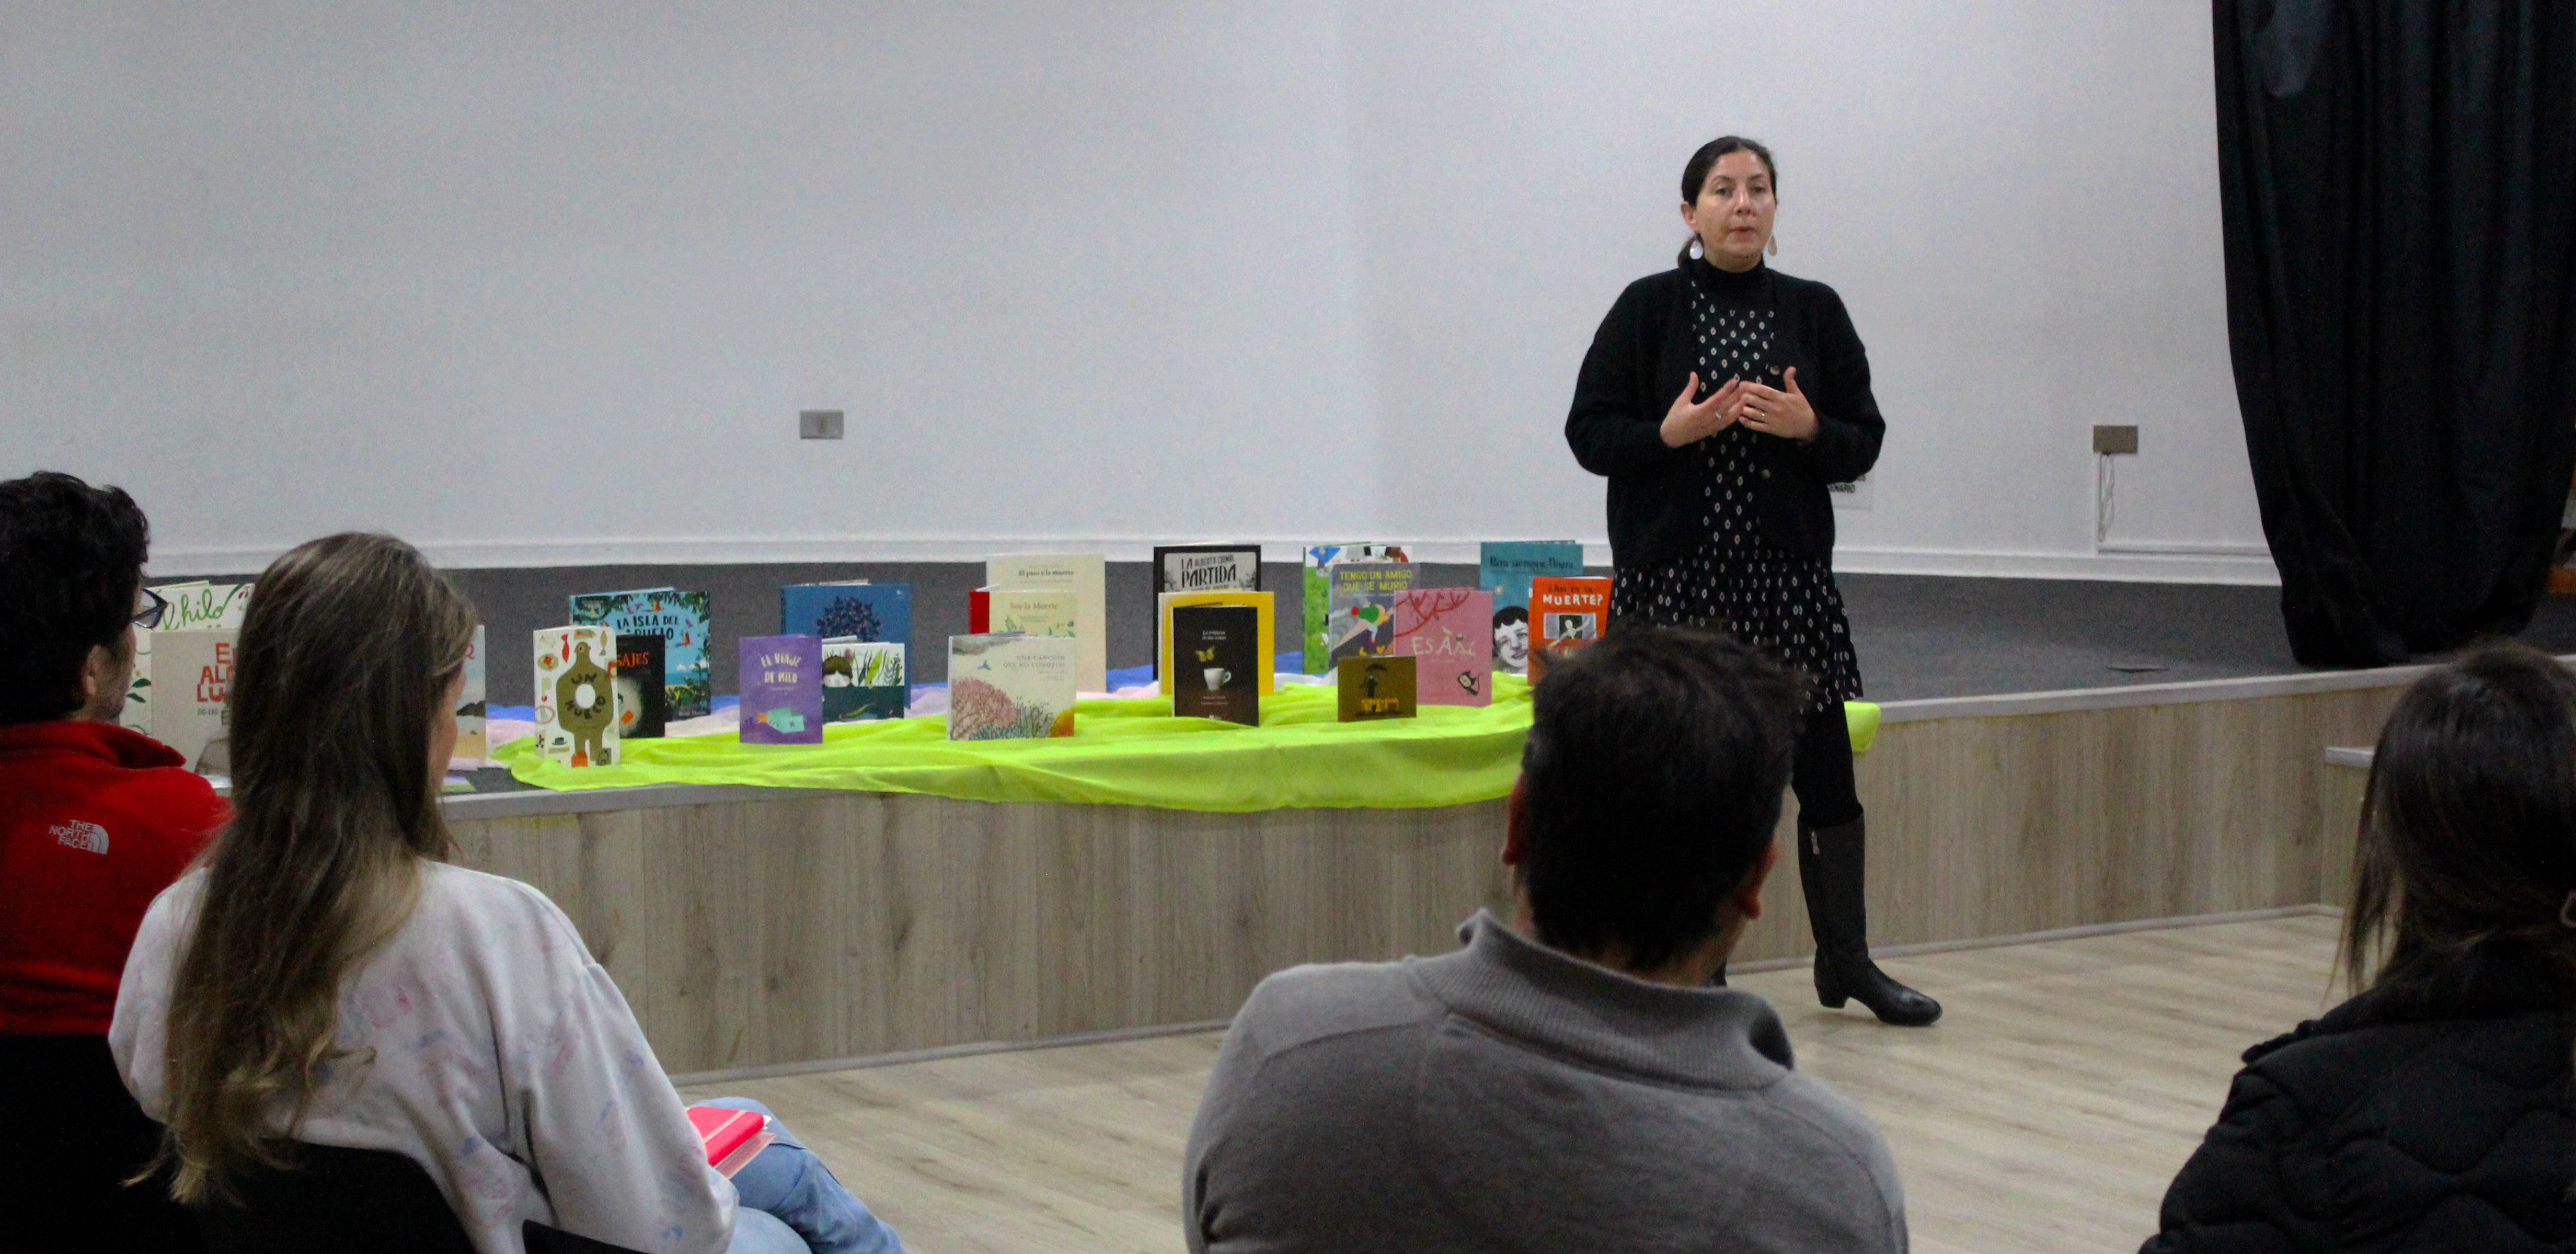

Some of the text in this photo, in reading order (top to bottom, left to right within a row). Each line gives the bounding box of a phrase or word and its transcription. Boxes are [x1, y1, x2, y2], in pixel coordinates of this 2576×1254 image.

[1182, 558, 1192, 569] LA
[1182, 564, 1236, 588] PARTIDA
[1340, 570, 1412, 580] TENGO UN AMIGO
[1343, 582, 1360, 591] QUE
[1364, 581, 1375, 590] SE
[1543, 594, 1603, 606] MUERTE?
[617, 615, 679, 629] LA ISLA DEL
[761, 655, 772, 667] EL
[571, 672, 597, 685] UN
[764, 671, 774, 683] DE
[70, 819, 94, 832] THE
[49, 825, 90, 842] NORTH
[59, 836, 88, 849] FACE
